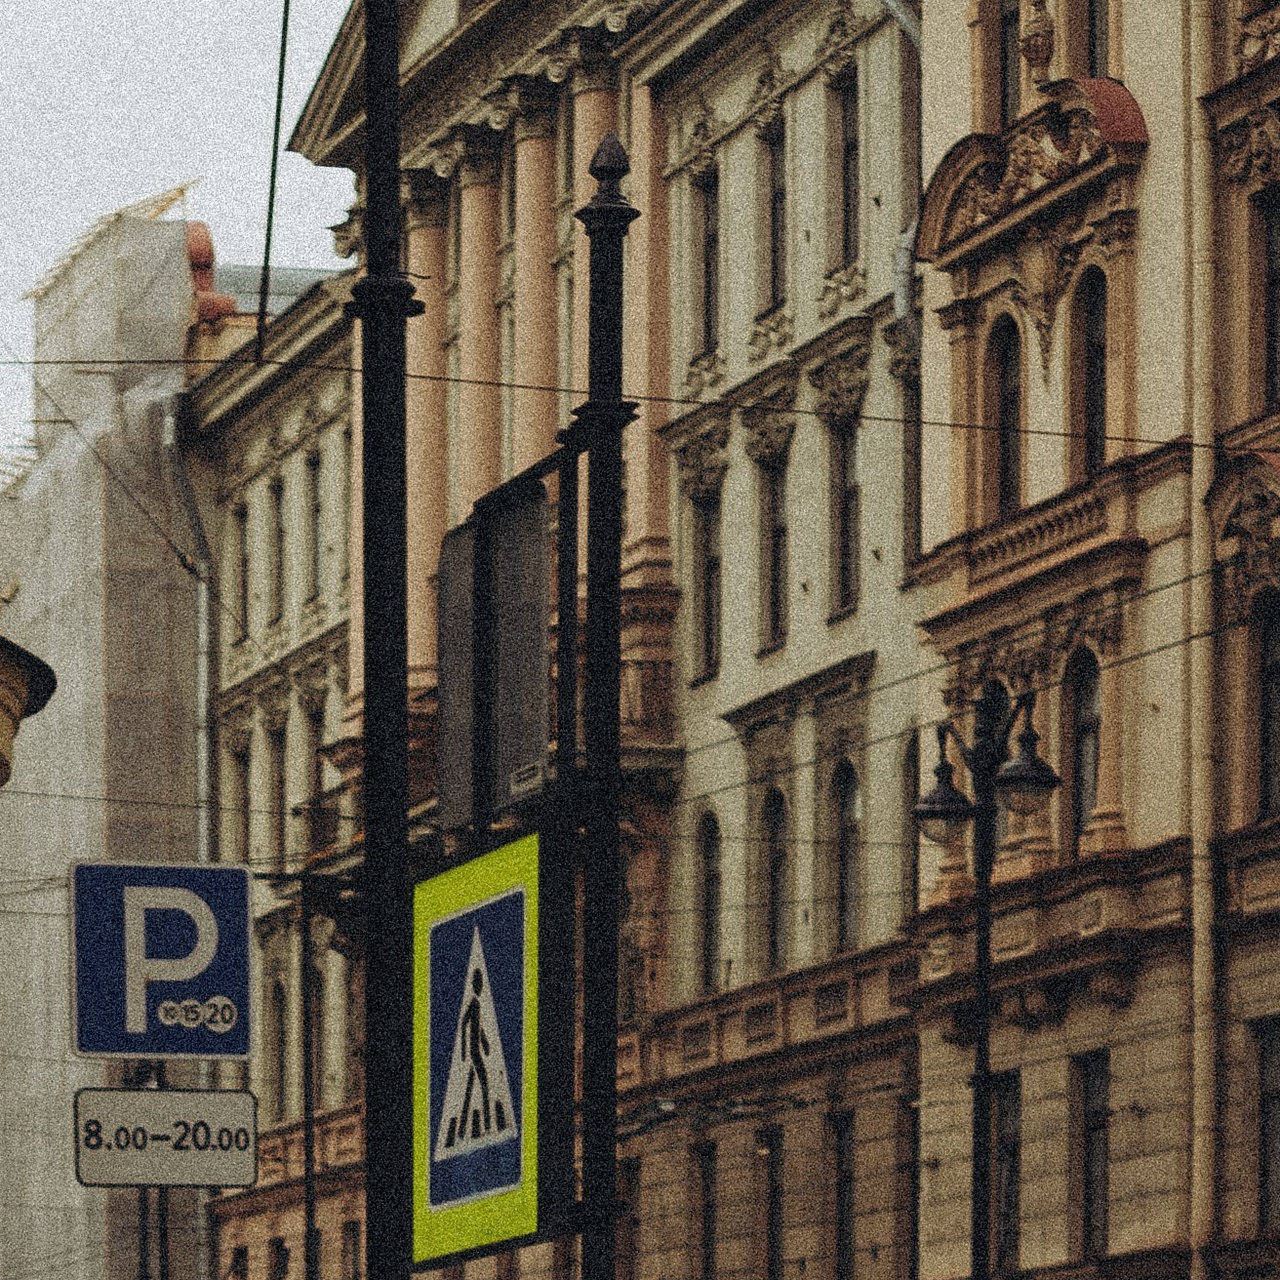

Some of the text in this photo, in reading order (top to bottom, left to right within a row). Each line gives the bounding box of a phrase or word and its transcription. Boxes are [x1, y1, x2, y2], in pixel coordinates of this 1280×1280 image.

[124, 886, 219, 1033] P
[182, 1004, 200, 1022] 15
[206, 1002, 234, 1025] 20
